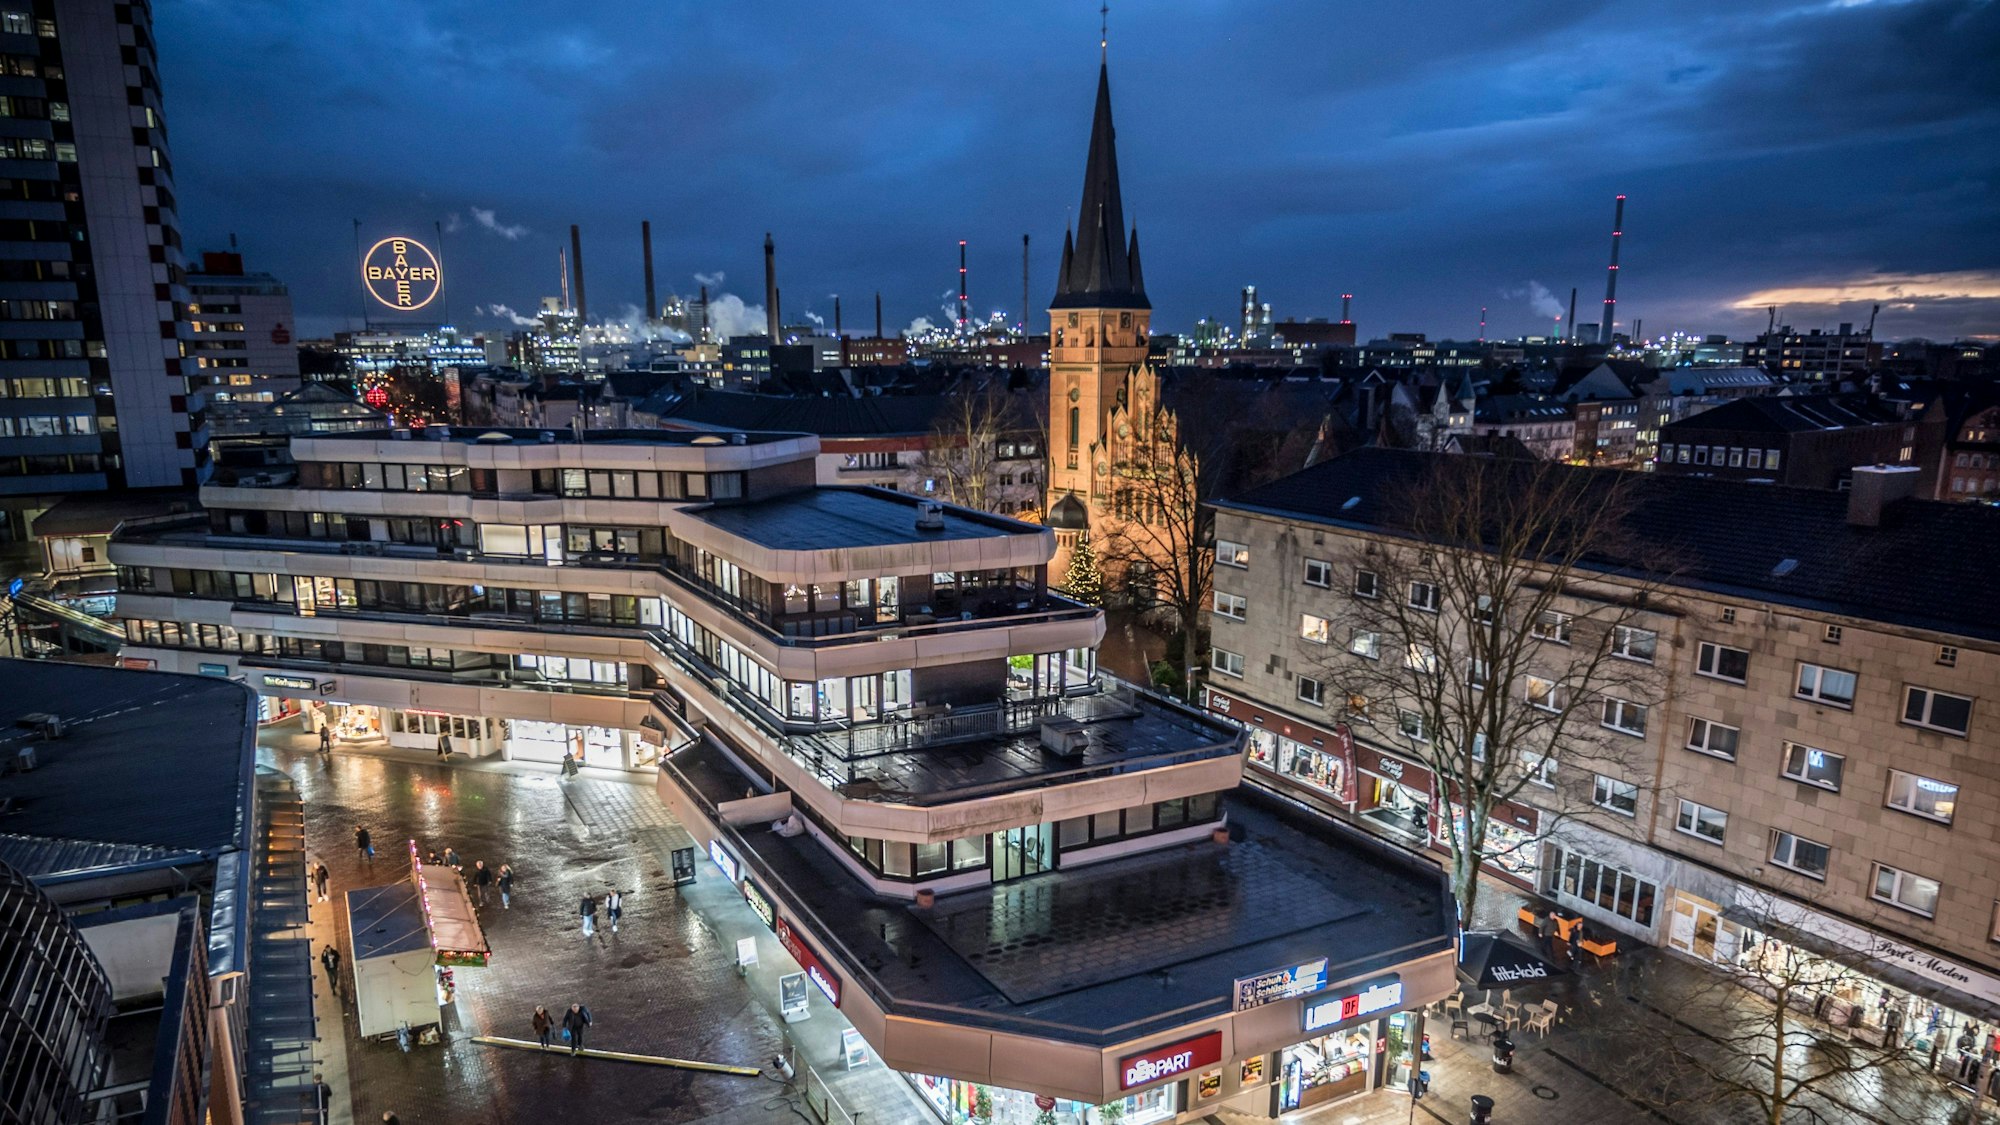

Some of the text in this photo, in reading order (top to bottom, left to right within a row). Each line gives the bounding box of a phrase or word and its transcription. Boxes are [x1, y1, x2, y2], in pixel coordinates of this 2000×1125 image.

[368, 266, 436, 281] BAYER
[393, 241, 412, 306] BAYER
[1491, 963, 1547, 981] fritz-kola
[1918, 958, 1969, 983] Moden
[1257, 976, 1282, 988] Schuh
[1127, 1051, 1192, 1086] DERPART
